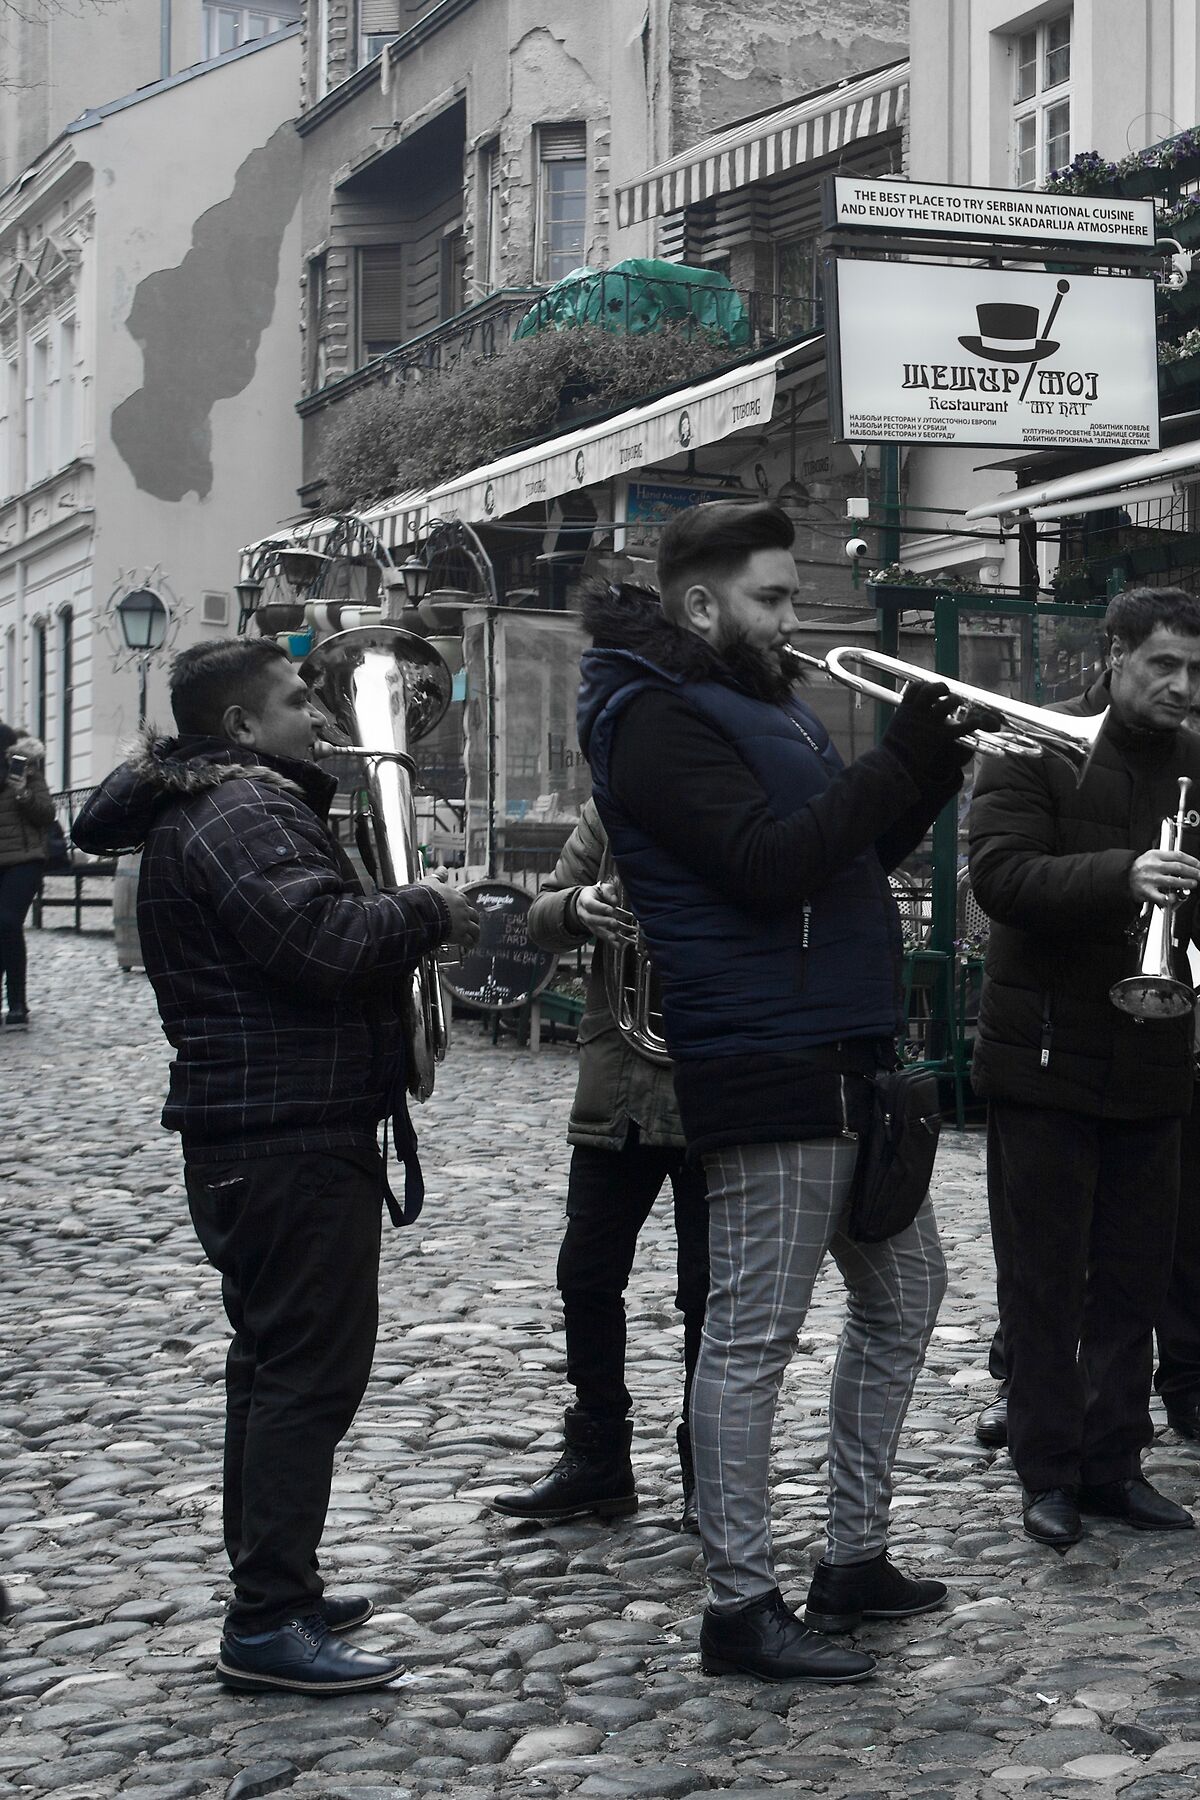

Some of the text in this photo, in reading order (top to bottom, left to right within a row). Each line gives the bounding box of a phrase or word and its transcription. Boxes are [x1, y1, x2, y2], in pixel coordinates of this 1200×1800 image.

[854, 190, 1135, 221] THE BEST PLACE TO TRY SERBIAN NATIONAL CUISINE
[841, 203, 1149, 236] AND ENJOY THE TRADITIONAL SKADARLIJA ATMOSPHERE
[732, 398, 761, 424] TUBORG
[929, 396, 1009, 413] Restaurant
[849, 414, 882, 422] НАЈБОЉИ
[883, 415, 916, 423] РЕСТОРАН
[923, 417, 971, 425] ЈУГОИСТОЧНОЈ
[971, 418, 998, 426] ЕВРОПИ
[883, 423, 917, 431] РЕСТОРАН
[922, 424, 947, 432] СРБИЈИ
[1021, 428, 1151, 439] КУЛТУРНО-ПРОСВЕТНЕ ЗАЈЕДНИЦЕ СРБИЈЕ
[1090, 423, 1150, 432] ДОБИТНИК ПОВЕЉЕ
[883, 430, 917, 438] РЕСТОРАН
[923, 431, 956, 440] БЕОГРАДУ
[1022, 435, 1058, 443] ДОБИТНИК
[1058, 436, 1094, 444] ПРИЗНАЊА
[619, 442, 643, 465] TUBORG
[547, 732, 587, 771] Han
